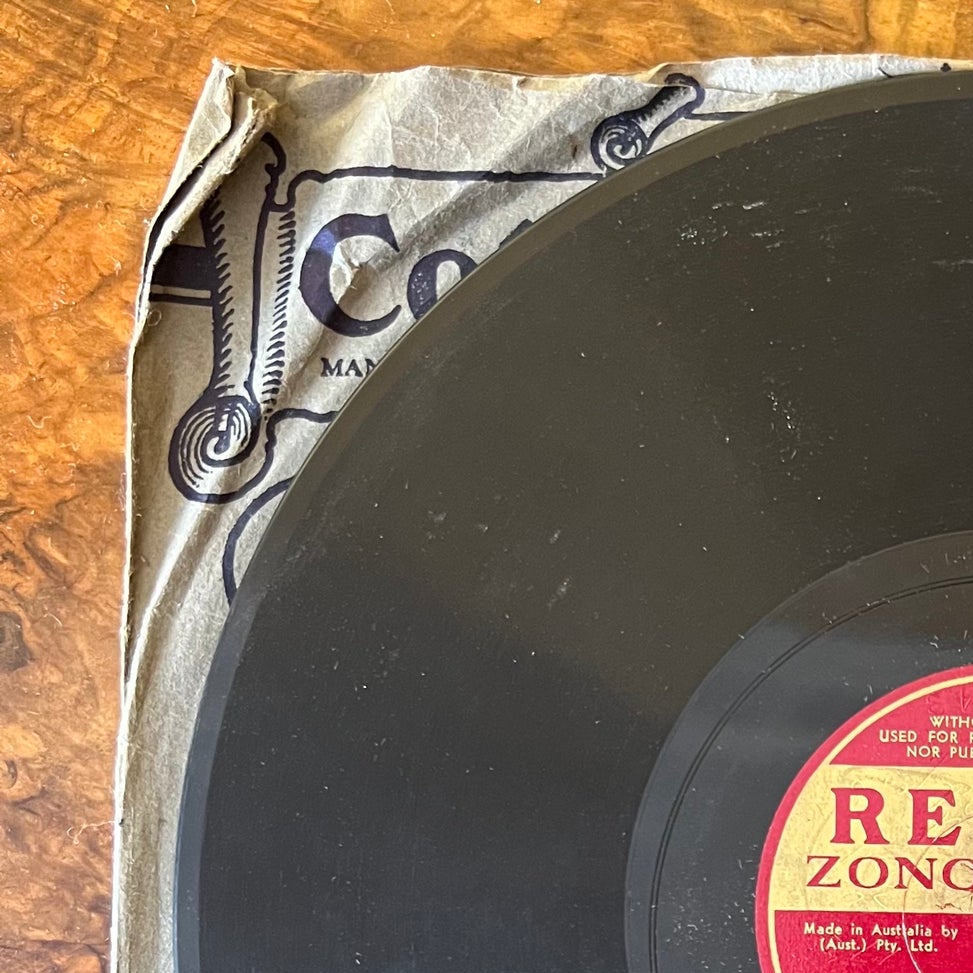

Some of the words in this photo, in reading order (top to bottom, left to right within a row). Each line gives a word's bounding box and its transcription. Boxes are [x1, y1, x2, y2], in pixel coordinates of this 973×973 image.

[879, 729, 917, 742] USED
[928, 730, 958, 744] FOR
[907, 746, 940, 758] NOR
[804, 922, 842, 935] Made
[852, 923, 862, 935] in
[872, 923, 931, 937] Australia
[942, 925, 958, 939] by
[820, 938, 866, 952] (Aust.)
[876, 939, 901, 953] Pty.
[911, 939, 937, 952] Ltd.
